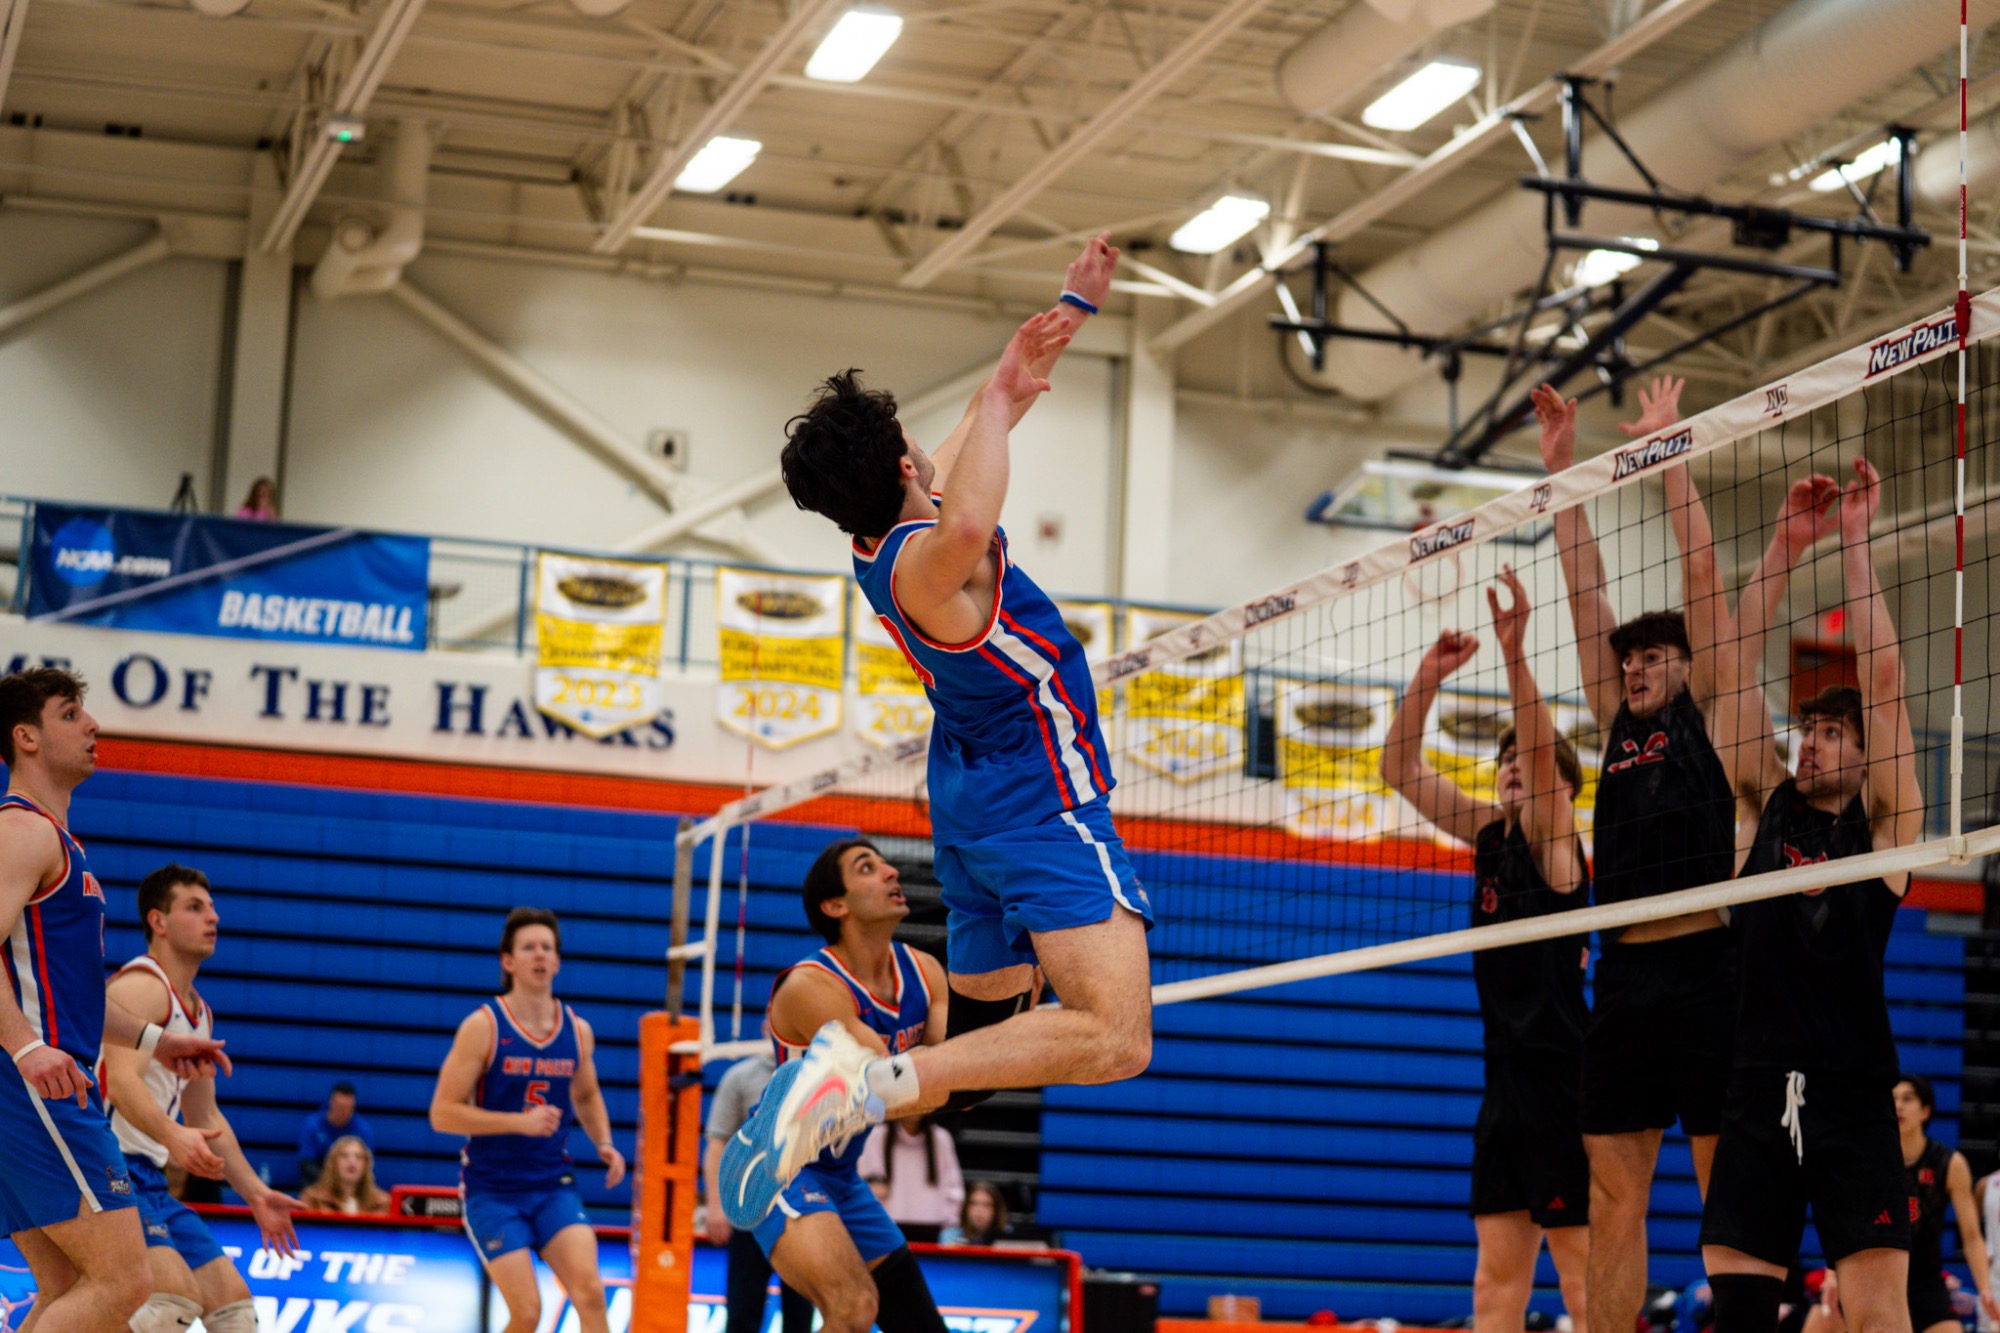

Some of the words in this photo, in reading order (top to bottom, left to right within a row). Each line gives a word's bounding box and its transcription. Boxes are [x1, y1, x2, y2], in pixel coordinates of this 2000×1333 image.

[218, 590, 414, 643] BASKETBALL
[112, 653, 212, 711] OF
[250, 662, 391, 727] THE
[552, 673, 641, 710] 2023
[734, 685, 821, 720] 2024
[523, 1080, 550, 1114] 5
[248, 1248, 312, 1280] OF
[320, 1251, 416, 1284] THE
